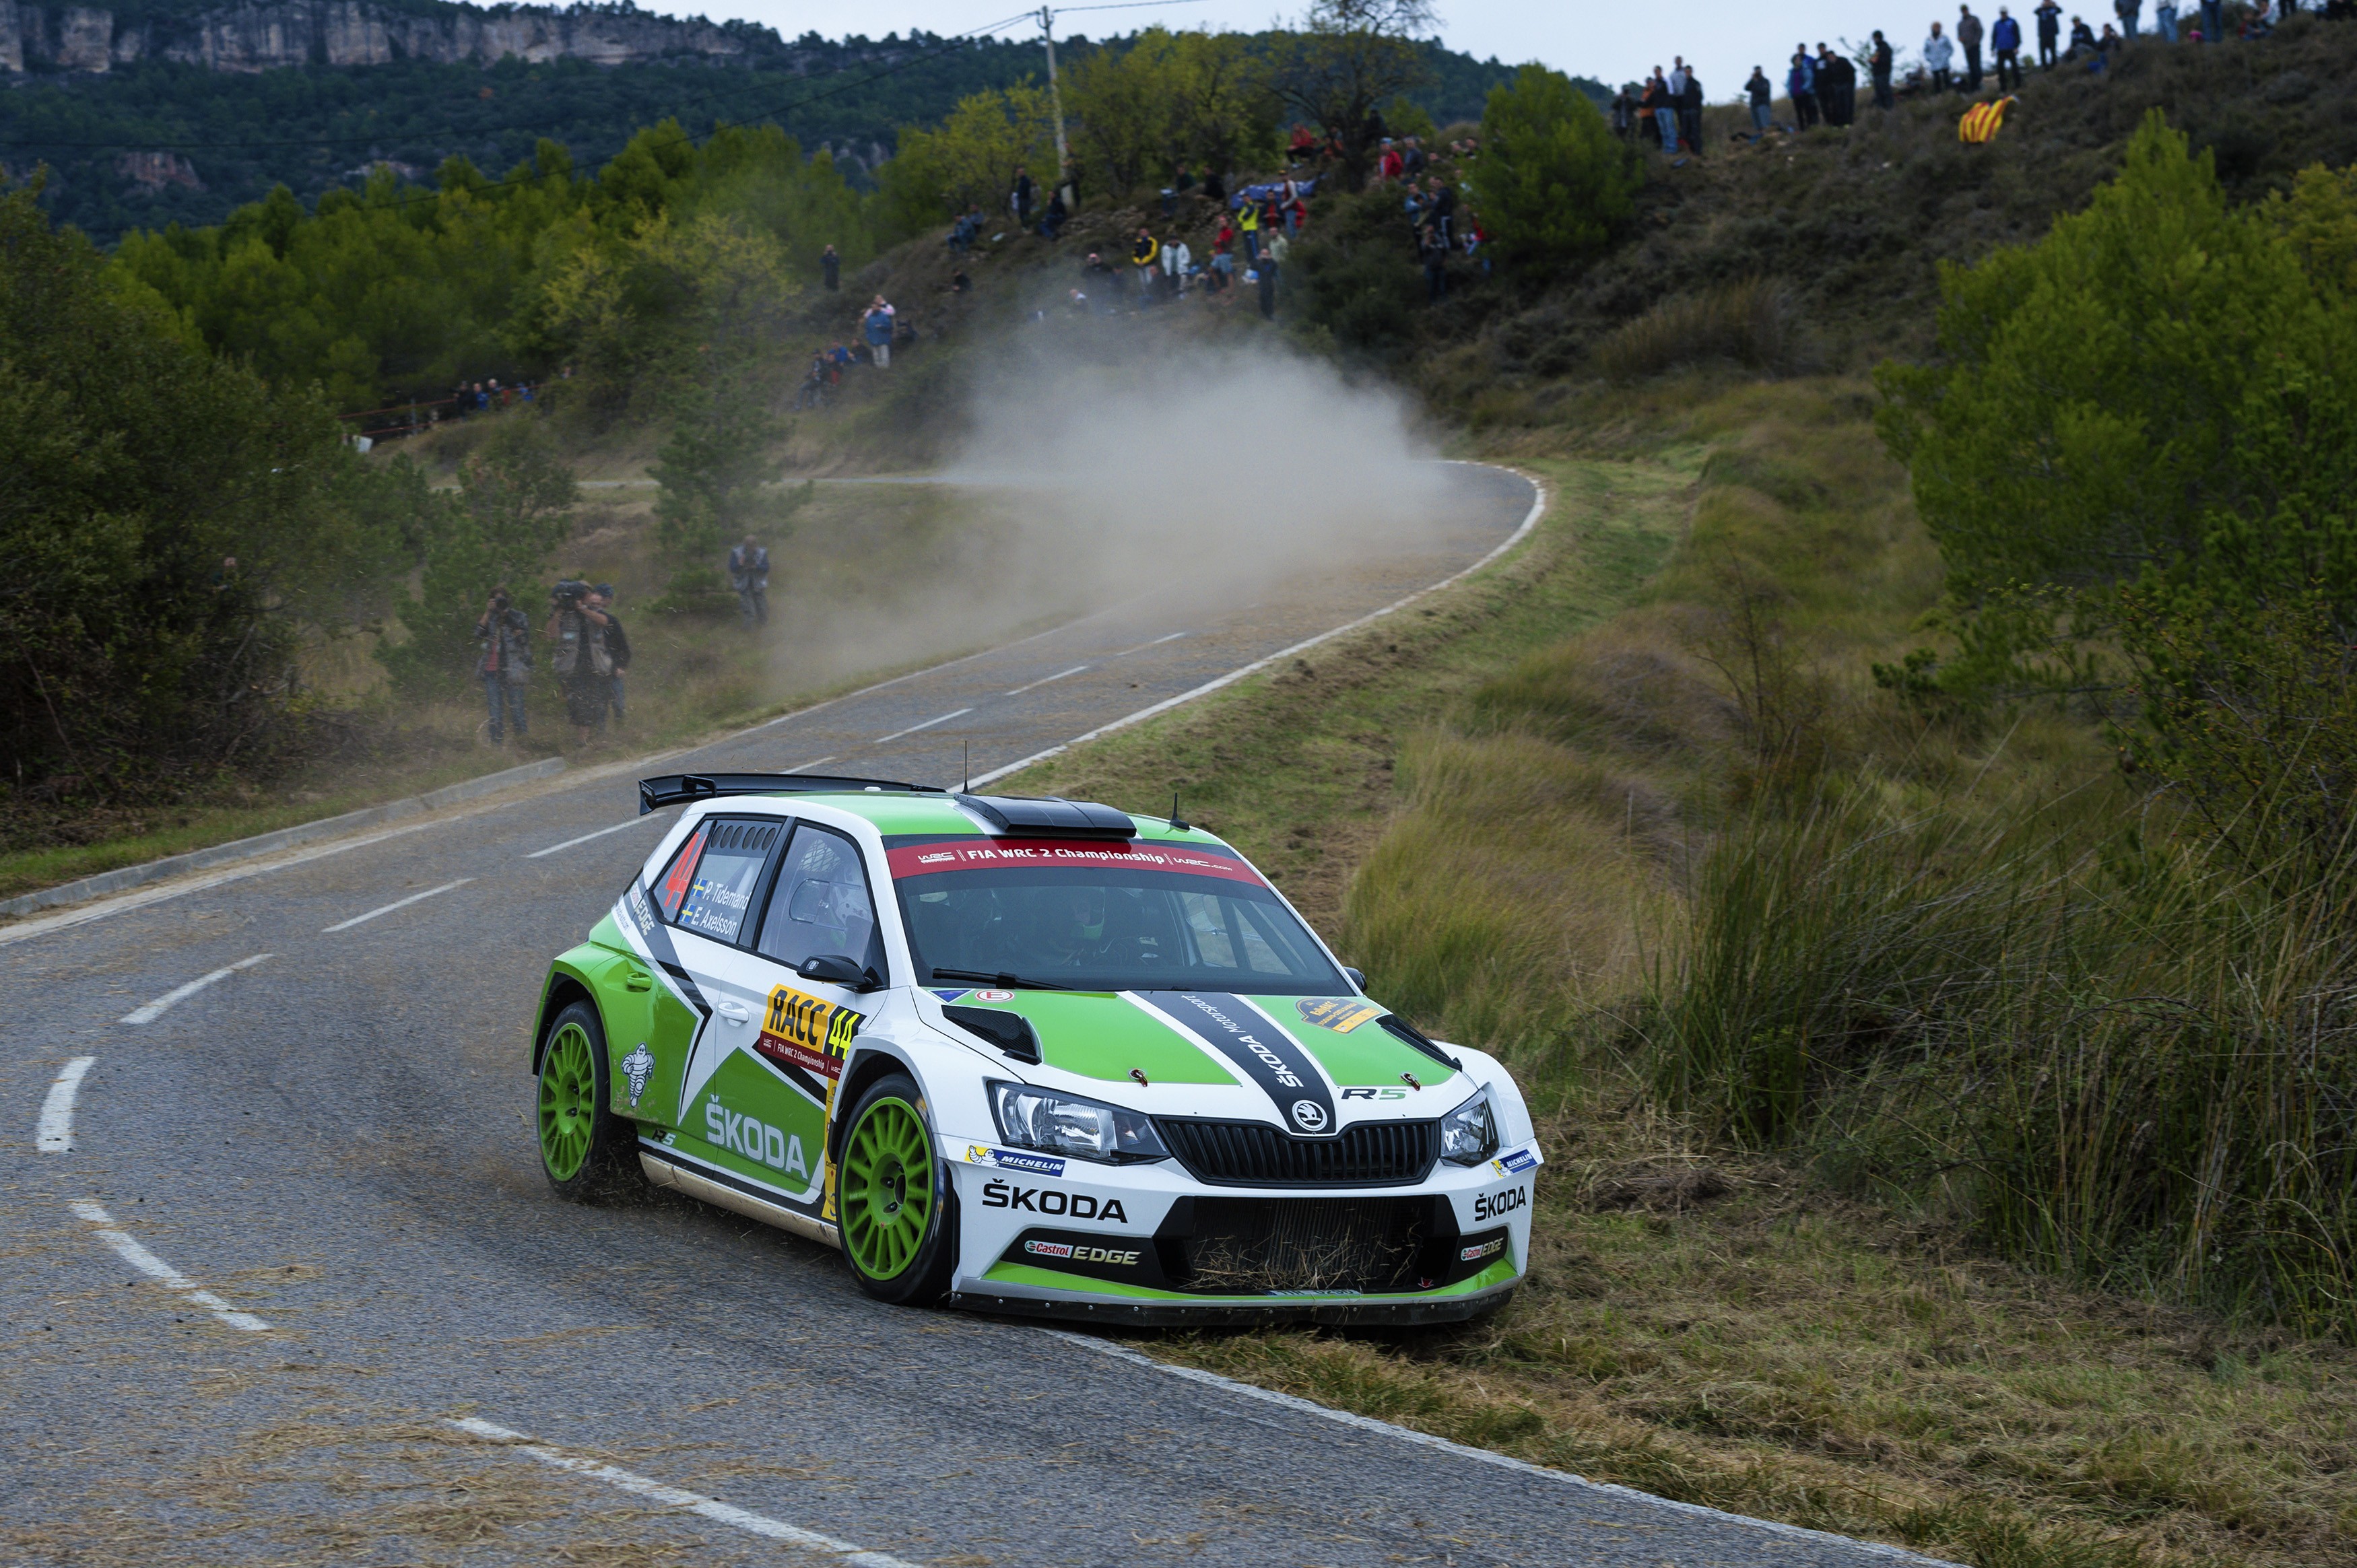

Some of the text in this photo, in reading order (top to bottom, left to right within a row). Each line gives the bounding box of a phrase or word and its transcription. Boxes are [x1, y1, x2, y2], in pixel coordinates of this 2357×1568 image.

[664, 831, 708, 910] 44
[967, 848, 1164, 865] FIA WRC 2 Championship
[702, 881, 752, 910] P. Tidemand
[634, 899, 656, 936] EDGE
[691, 906, 737, 936] E. Axelsson
[769, 989, 827, 1046] RACC
[828, 1009, 860, 1060] 44
[1181, 995, 1304, 1087] ŠKODA Motorsport
[785, 1046, 794, 1058] WRC
[793, 1049, 797, 1059] 2
[797, 1051, 825, 1071] Championship
[1341, 1089, 1407, 1100] R5
[651, 1129, 677, 1146] R5
[706, 1093, 808, 1180] ŠKODA
[1001, 1155, 1065, 1171] MICHELIN
[1506, 1153, 1533, 1168] MICHELIN
[982, 1178, 1128, 1224] ŠKODA
[1475, 1186, 1526, 1222] ŠKODA
[1036, 1242, 1142, 1266] Castrol EDGE
[1466, 1237, 1504, 1258] Castrol EDGE
